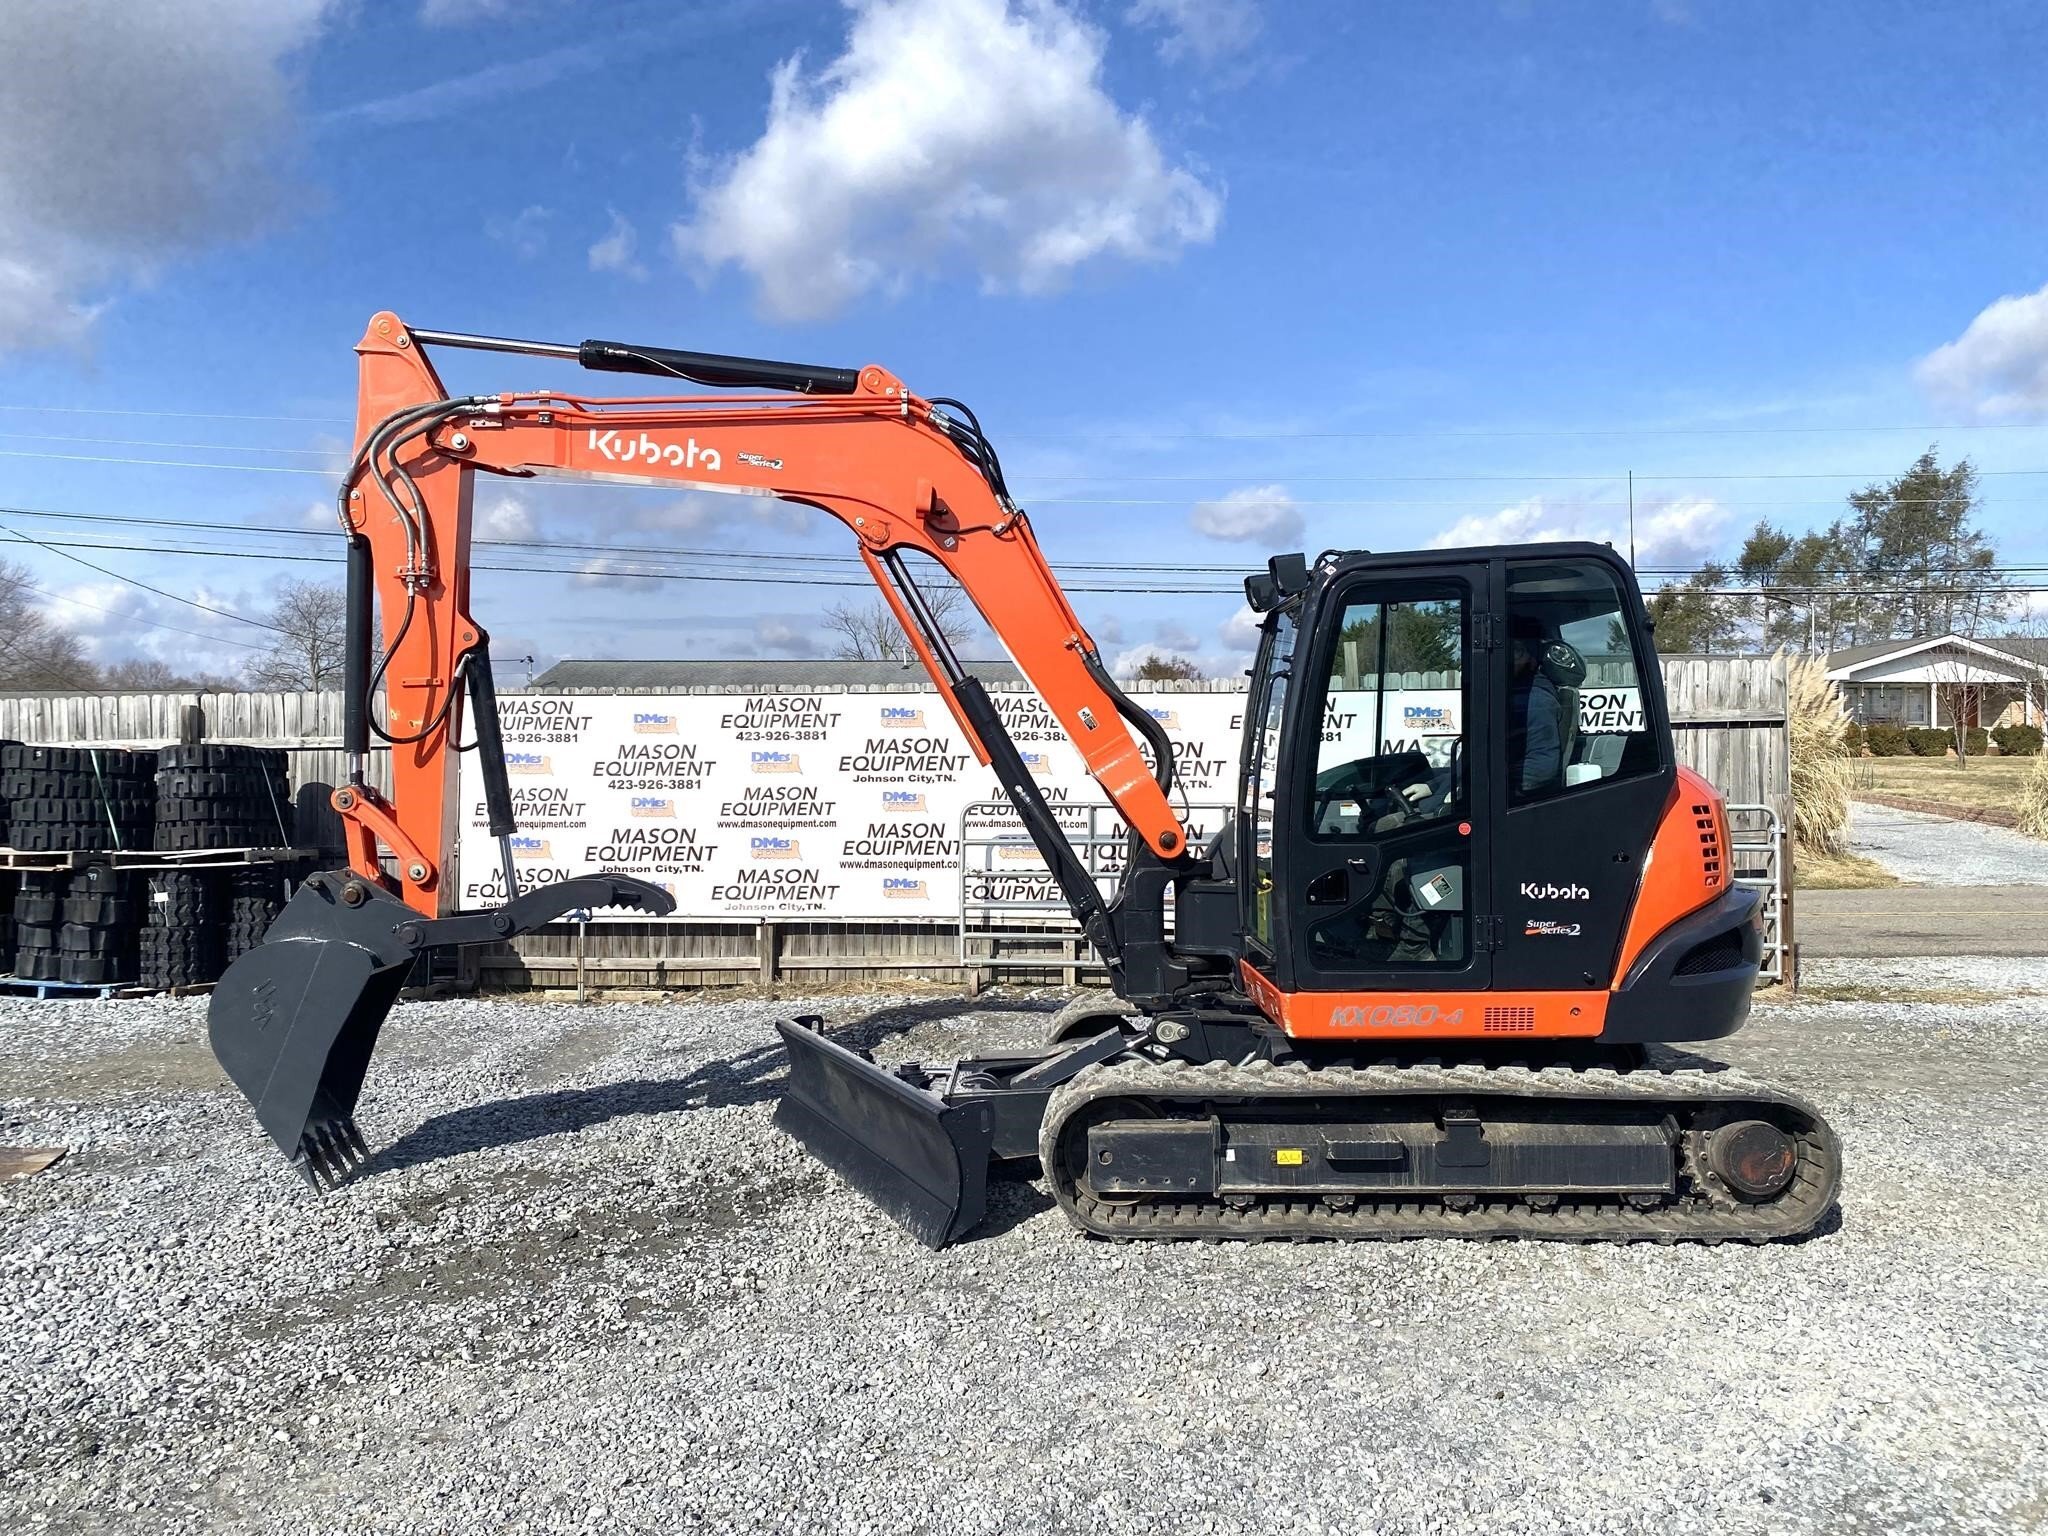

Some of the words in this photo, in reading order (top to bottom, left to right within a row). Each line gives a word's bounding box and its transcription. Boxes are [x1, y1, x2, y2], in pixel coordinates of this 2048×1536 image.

[588, 428, 721, 471] Kubota
[498, 701, 574, 715] MASON
[745, 698, 822, 712] MASON
[498, 716, 592, 731] UIPMENT
[721, 713, 841, 729] EQUIPMENT
[500, 733, 578, 743] 23-926-3881
[736, 731, 827, 741] 423-926-3881
[618, 744, 697, 759] MASON
[865, 738, 949, 754] MASON
[593, 761, 717, 777] EQUIPMENT
[839, 755, 970, 771] EQUIPMENT
[608, 779, 701, 790] 423-926-3881
[853, 774, 904, 783] Johnson
[908, 774, 957, 784] City,TN.
[509, 788, 568, 802] ASON
[744, 786, 818, 801] MASON
[475, 803, 587, 817] EIPMENT
[720, 802, 836, 817] EQUIPMENT
[717, 819, 837, 831] www.dmasonequipment.com
[867, 823, 945, 839] MASON
[611, 828, 697, 844] MASON
[585, 845, 718, 862] EQUIPMENT
[599, 865, 651, 874] Johnson
[655, 864, 705, 875] City,TN.
[839, 859, 960, 871] www.dmasonequipment.co
[737, 869, 819, 884] MASON
[711, 885, 840, 901] EQUIPMENT
[1521, 883, 1590, 900] Kubota
[724, 903, 775, 911] Johnson
[779, 903, 827, 912] City,TN.
[1526, 919, 1557, 929] Super
[1328, 1004, 1465, 1028] KX080-4
